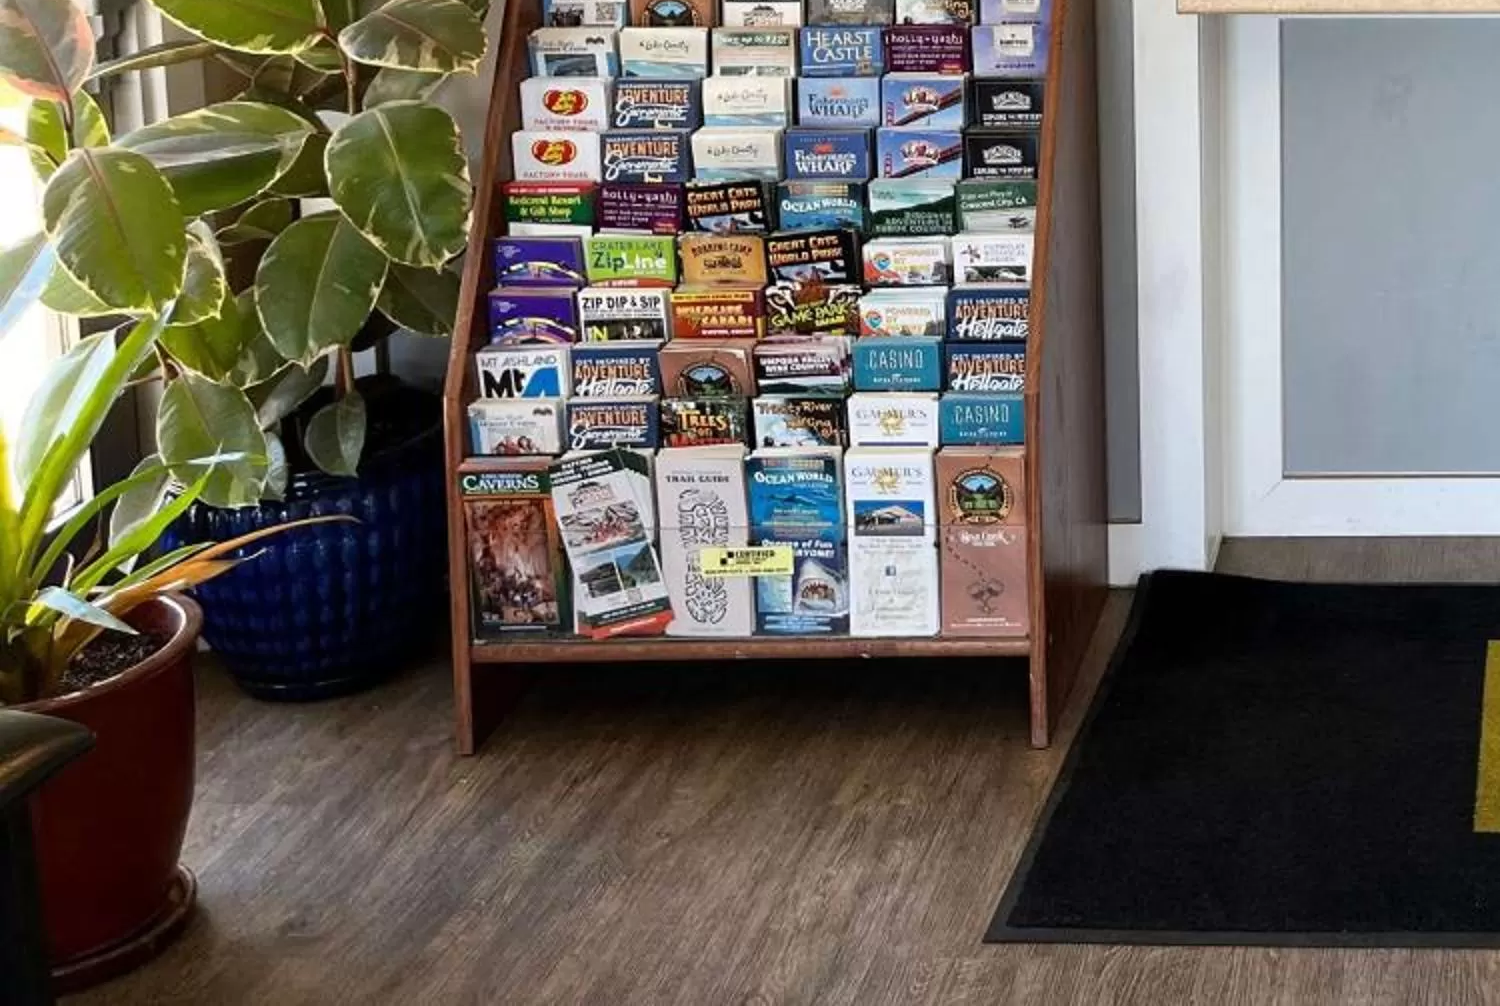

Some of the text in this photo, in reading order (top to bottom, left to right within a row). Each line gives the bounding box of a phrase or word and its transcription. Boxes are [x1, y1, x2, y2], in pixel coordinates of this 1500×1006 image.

[808, 31, 873, 46] HEARST
[813, 47, 872, 62] CASTLE
[618, 90, 689, 104] ADVENTURE
[810, 103, 868, 116] WHARF
[605, 142, 678, 155] ADVENTURE
[796, 158, 857, 173] WHARF
[781, 197, 857, 212] OCEAN WORLD
[591, 242, 627, 250] CRATER
[581, 297, 603, 310] ZIP
[607, 297, 628, 309] DIP
[639, 296, 661, 309] SIP
[955, 304, 1029, 319] ADVENTURE
[502, 355, 557, 367] ASHLAND
[869, 349, 923, 369] CASINO
[951, 359, 1025, 373] ADVENTURE
[575, 364, 650, 379] ADVENTURE
[801, 401, 832, 412] River
[571, 410, 647, 425] ADVENTURE
[676, 410, 728, 431] TREES
[955, 405, 1009, 424] CASINO
[462, 475, 540, 491] CAVERNS
[666, 475, 730, 483] TRAIL GUIDE
[754, 471, 834, 485] OCEAN WORLD
[813, 540, 833, 549] Fun
